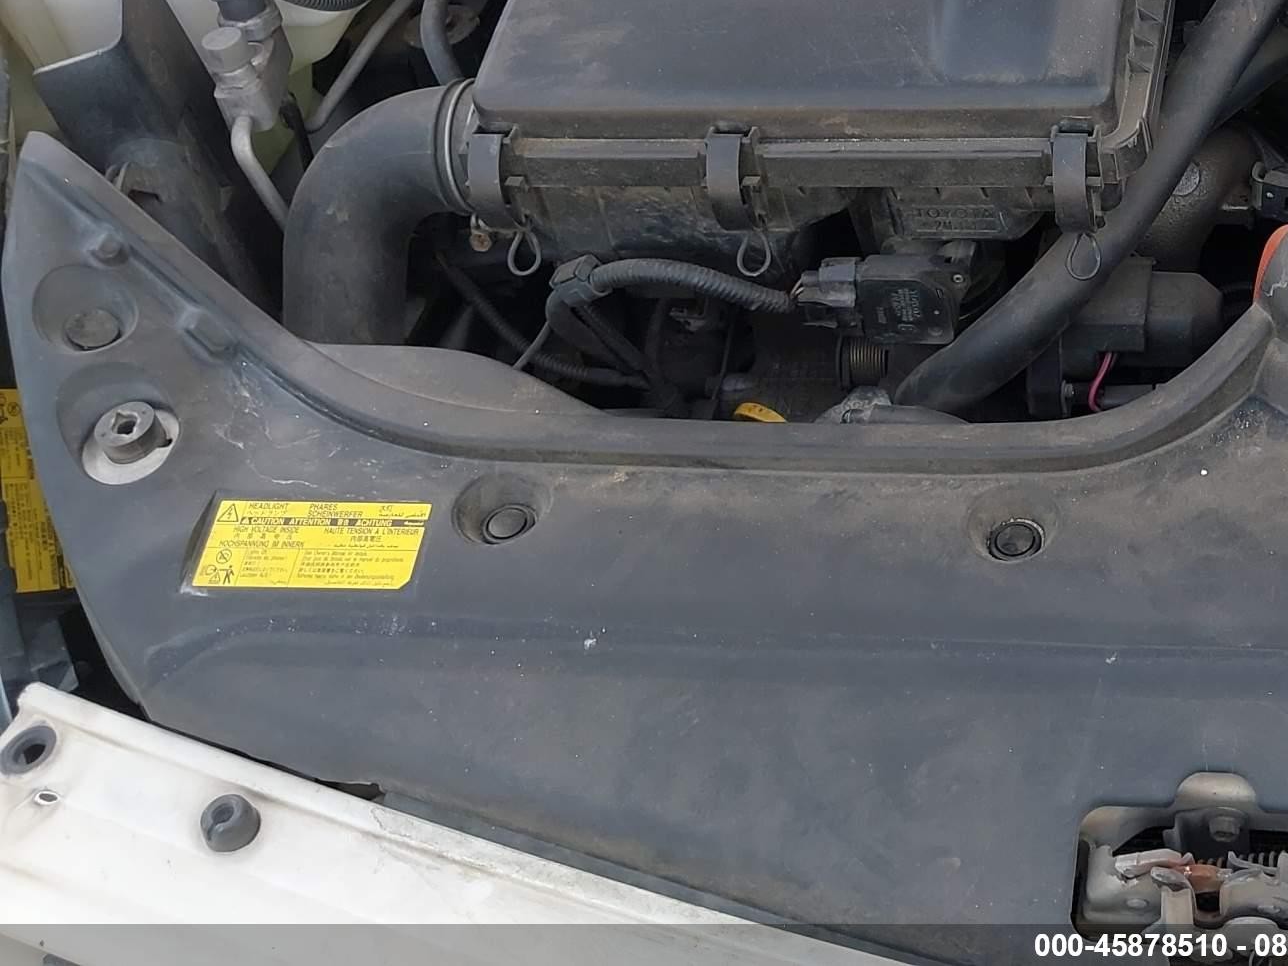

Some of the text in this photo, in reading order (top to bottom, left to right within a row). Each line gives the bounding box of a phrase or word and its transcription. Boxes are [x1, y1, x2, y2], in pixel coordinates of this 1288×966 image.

[249, 502, 289, 510] HEADLIGHT
[309, 503, 338, 511] PHARES
[308, 510, 363, 518] SCHEINWERFER
[251, 517, 285, 525] CAUTION
[355, 519, 393, 527] ACHTUNG
[324, 527, 345, 535] HAUTE
